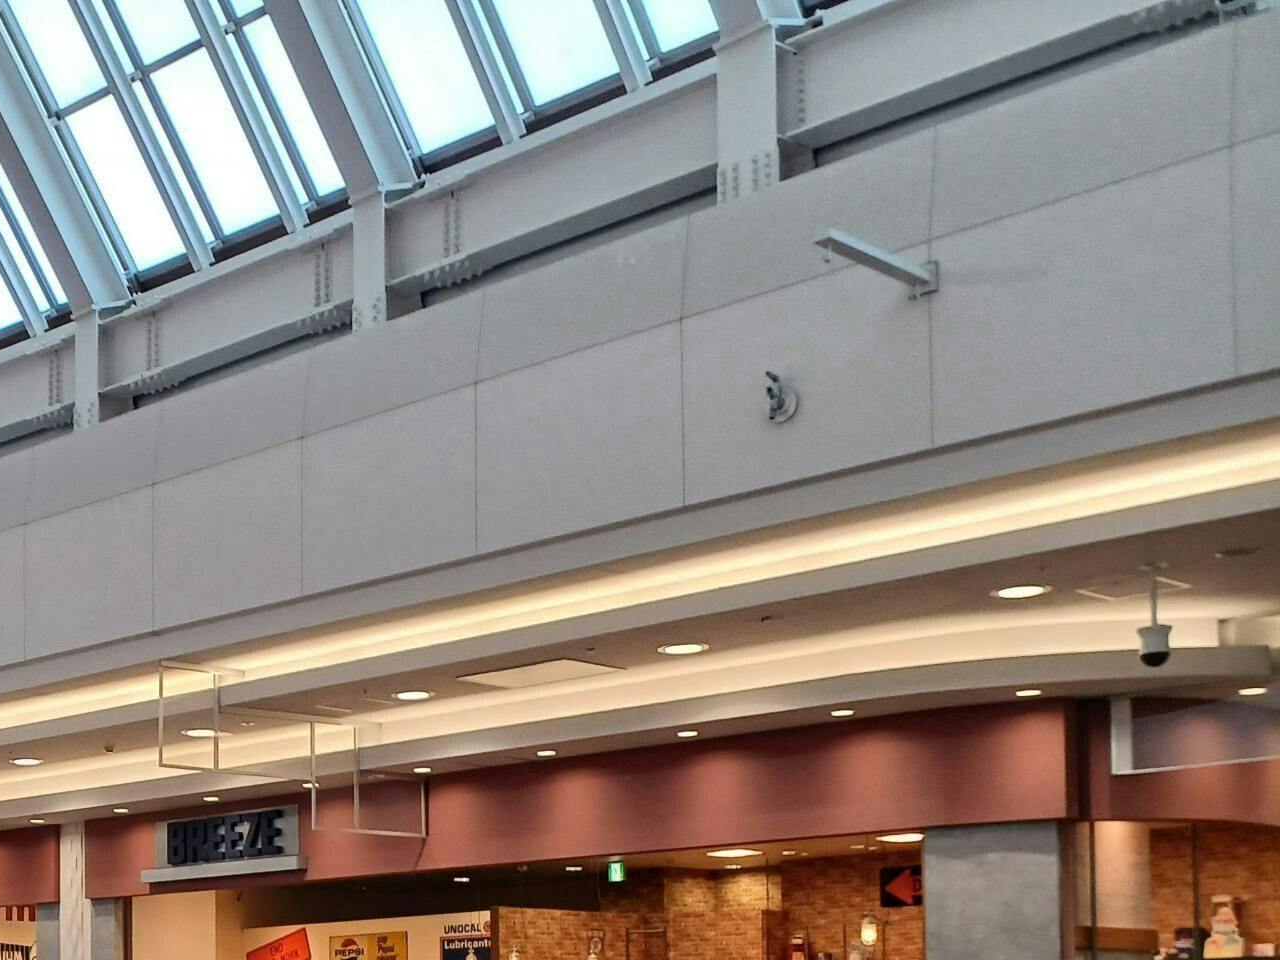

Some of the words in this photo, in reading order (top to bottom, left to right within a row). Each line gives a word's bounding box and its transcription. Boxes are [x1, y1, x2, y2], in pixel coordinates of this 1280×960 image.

[167, 809, 284, 866] BREEZE
[443, 923, 481, 934] UNOCAL
[335, 948, 364, 957] PEPSI
